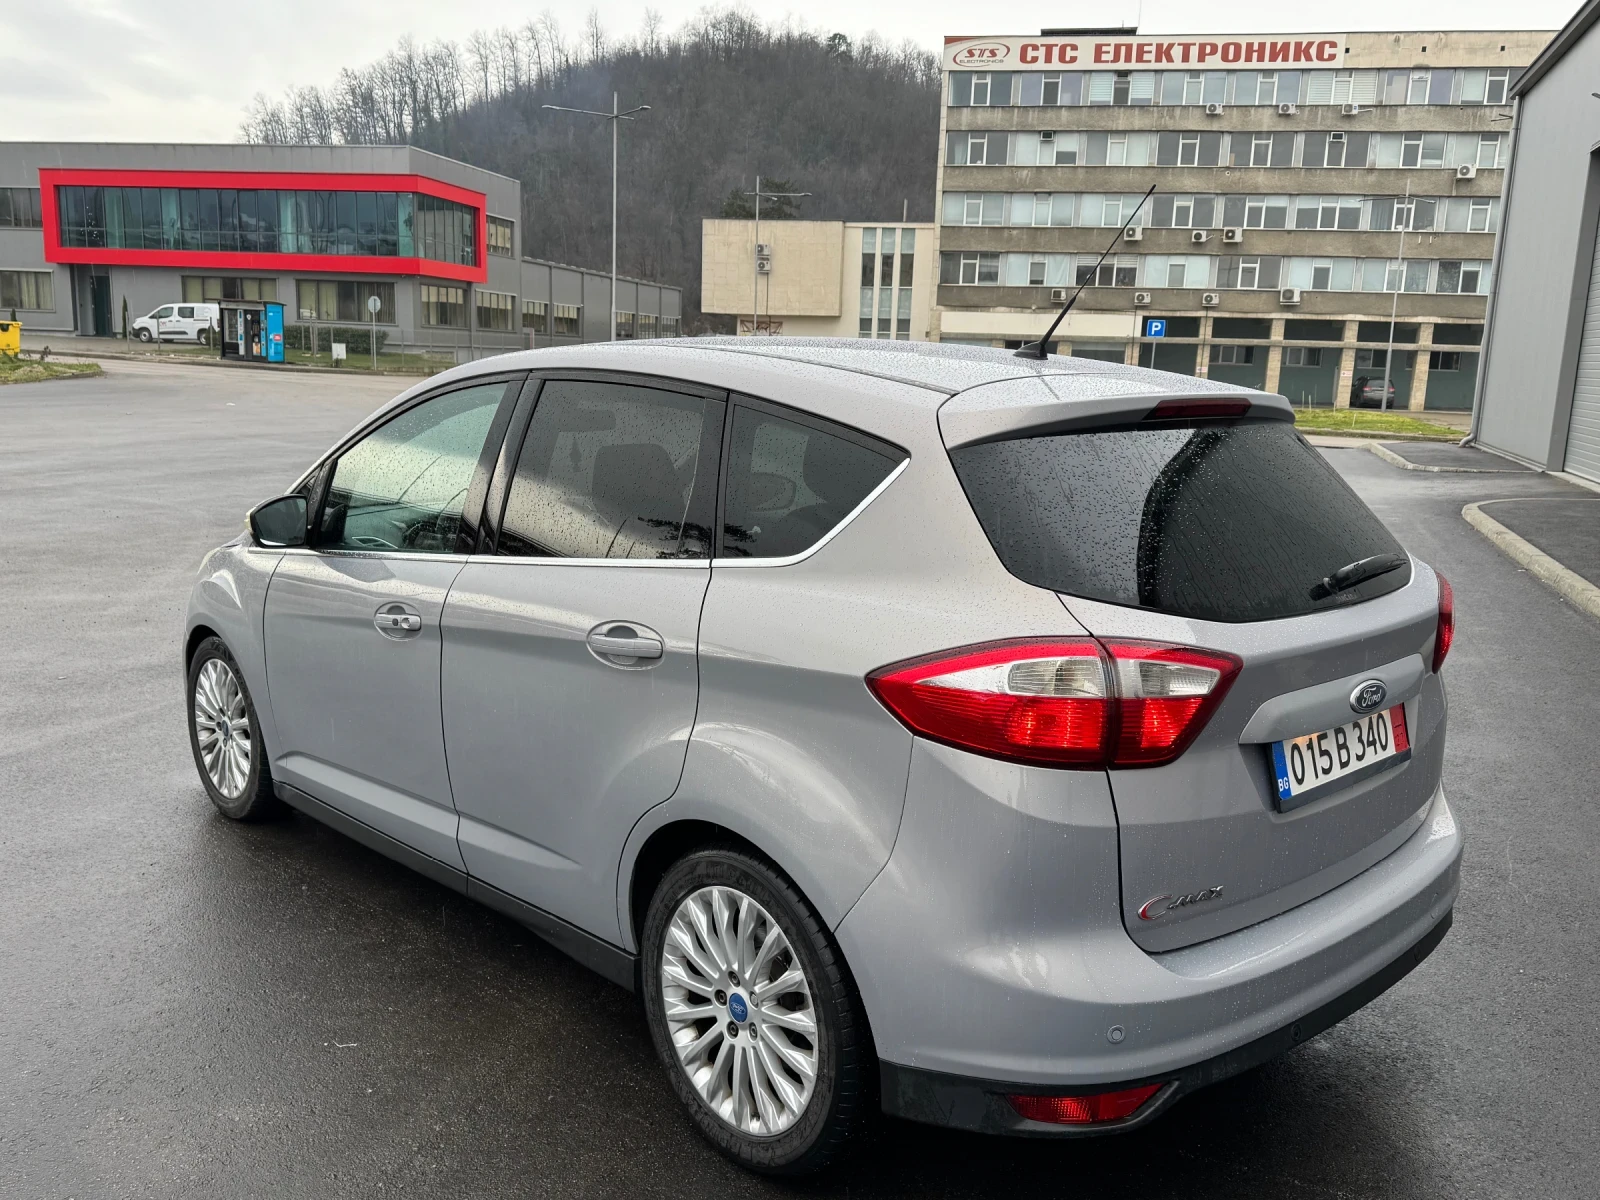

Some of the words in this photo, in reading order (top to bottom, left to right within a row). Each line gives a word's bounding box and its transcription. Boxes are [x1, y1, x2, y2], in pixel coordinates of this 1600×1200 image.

[964, 48, 1000, 58] STS
[1019, 43, 1079, 64] СТС
[1093, 40, 1338, 63] ЕЛЕКТРОНИКС
[1151, 322, 1162, 335] P
[1362, 686, 1382, 706] Ford
[1278, 777, 1290, 792] BG
